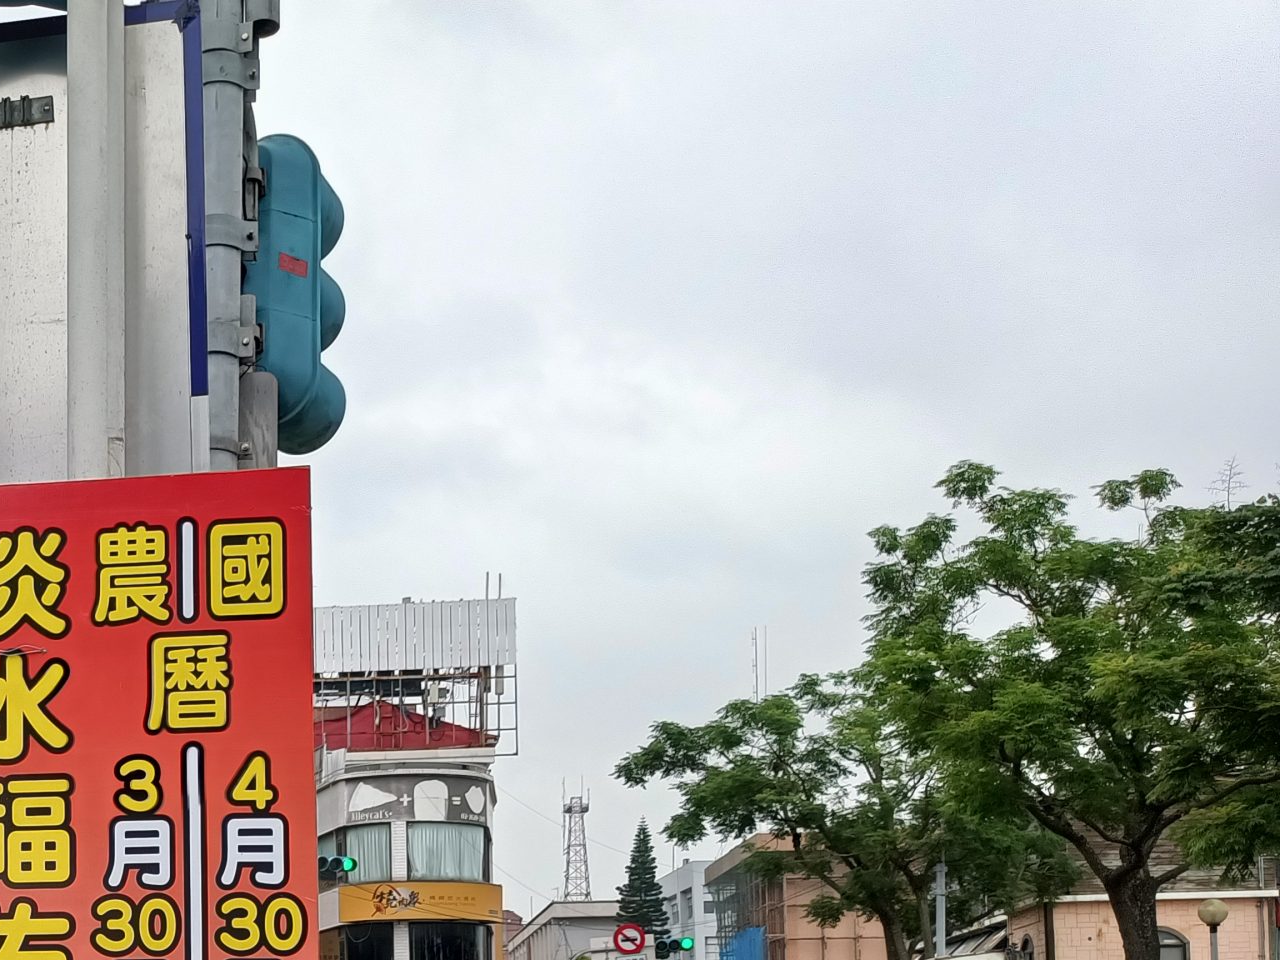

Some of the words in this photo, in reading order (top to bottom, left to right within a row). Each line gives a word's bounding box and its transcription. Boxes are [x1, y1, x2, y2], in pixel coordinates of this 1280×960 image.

[92, 522, 173, 626] 農
[206, 516, 287, 621] 國
[145, 629, 234, 735] 曆
